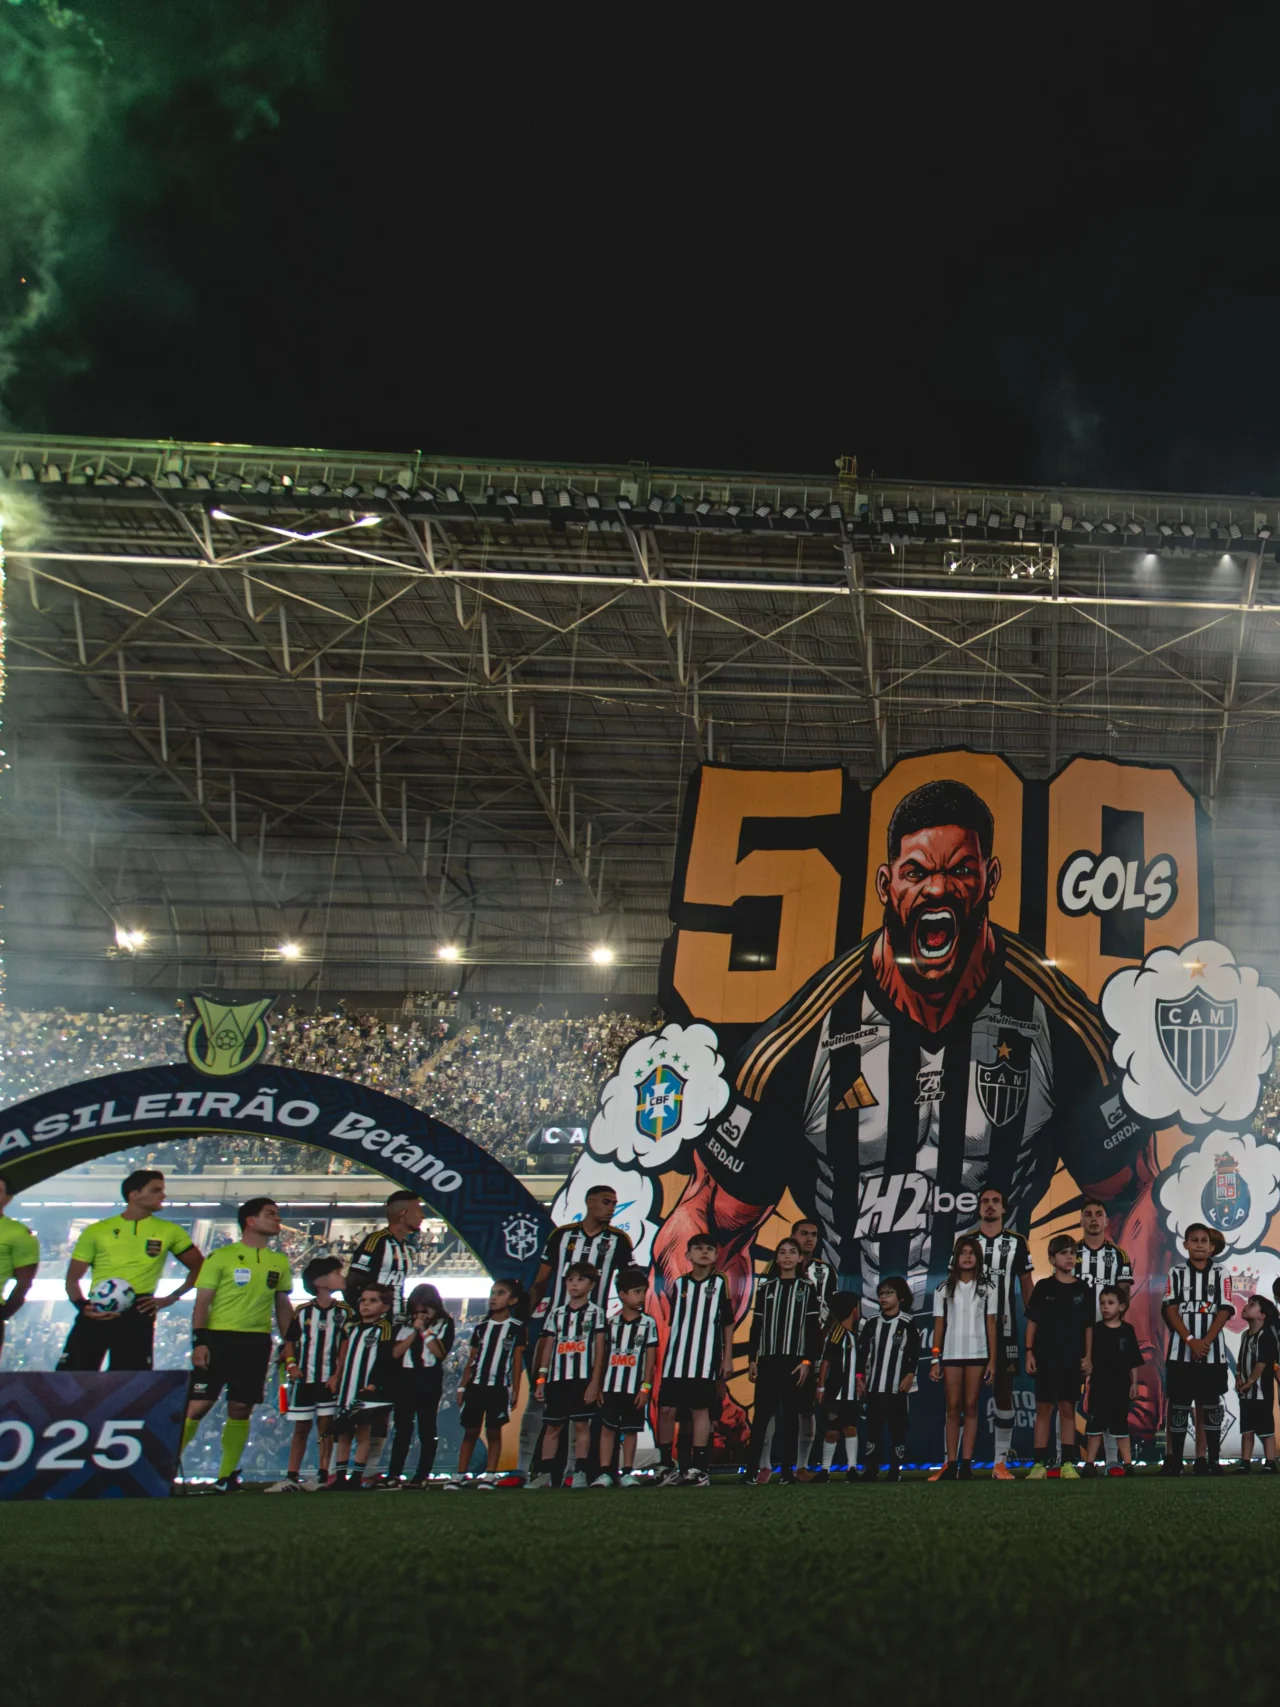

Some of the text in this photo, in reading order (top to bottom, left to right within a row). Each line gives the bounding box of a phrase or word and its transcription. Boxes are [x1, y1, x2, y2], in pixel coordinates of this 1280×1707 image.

[673, 751, 1199, 1024] 500
[1061, 855, 1173, 915] GOLS
[988, 1014, 1042, 1032] Multimarcas
[1168, 1008, 1225, 1025] CAM
[821, 1026, 879, 1049] Multimarcas
[983, 1072, 1023, 1086] CAM
[649, 1094, 669, 1106] CBF
[916, 1092, 944, 1103] ALE
[0, 1087, 463, 1193] ASILEIRÃO Betano
[544, 1127, 586, 1144] CA
[705, 1137, 745, 1173] ERDAU
[853, 1172, 979, 1239] H2be
[557, 1340, 586, 1354] BMG
[610, 1353, 637, 1368] BMG
[986, 1390, 1036, 1417] ATO
